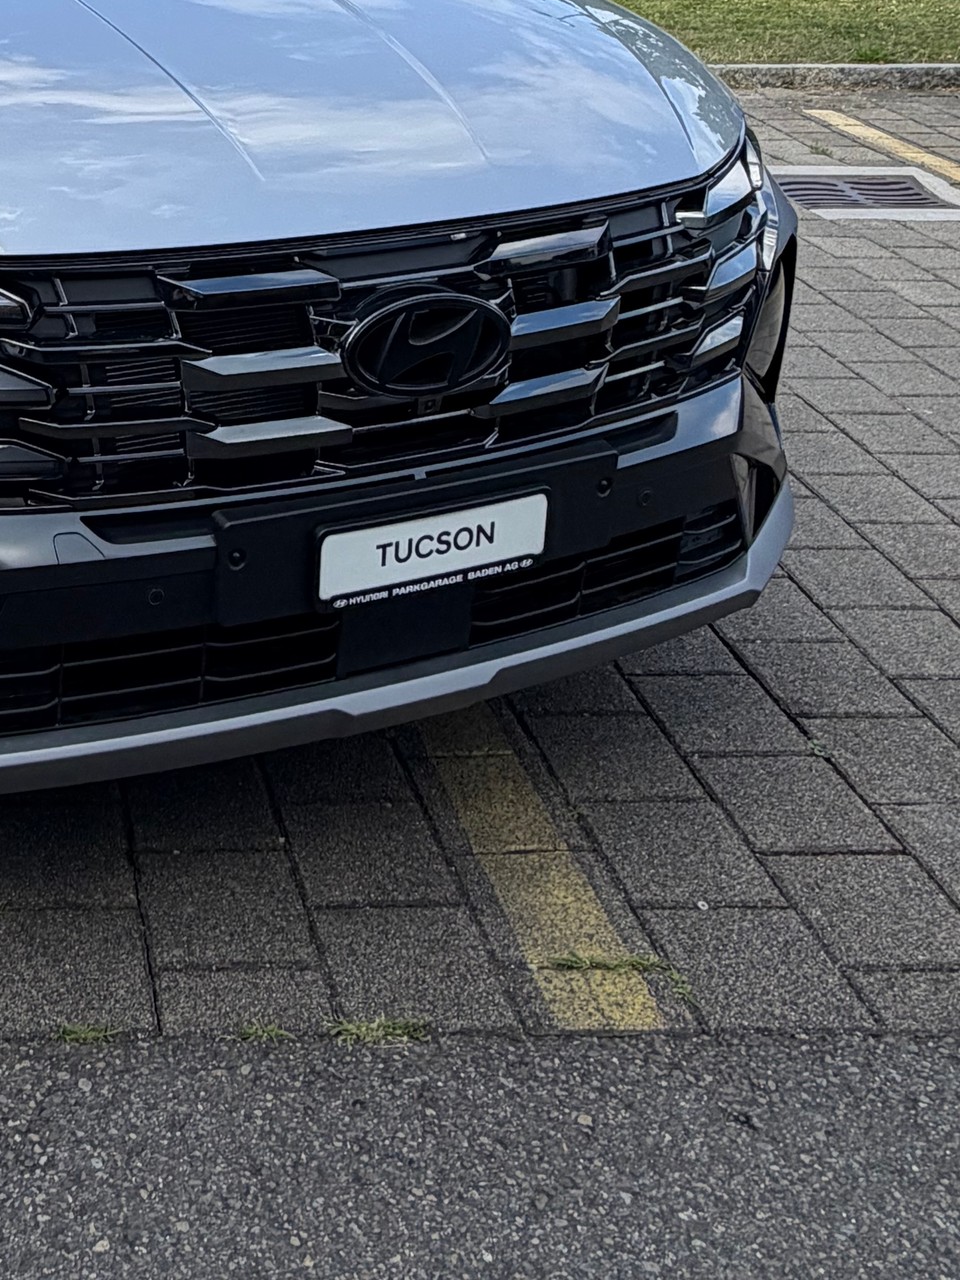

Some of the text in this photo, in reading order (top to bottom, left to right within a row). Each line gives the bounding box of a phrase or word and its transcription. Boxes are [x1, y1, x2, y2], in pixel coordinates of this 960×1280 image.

[376, 521, 496, 567] TUCSON
[392, 575, 464, 596] PARKGARAGE
[467, 565, 502, 581] BADEN
[504, 561, 519, 571] AG
